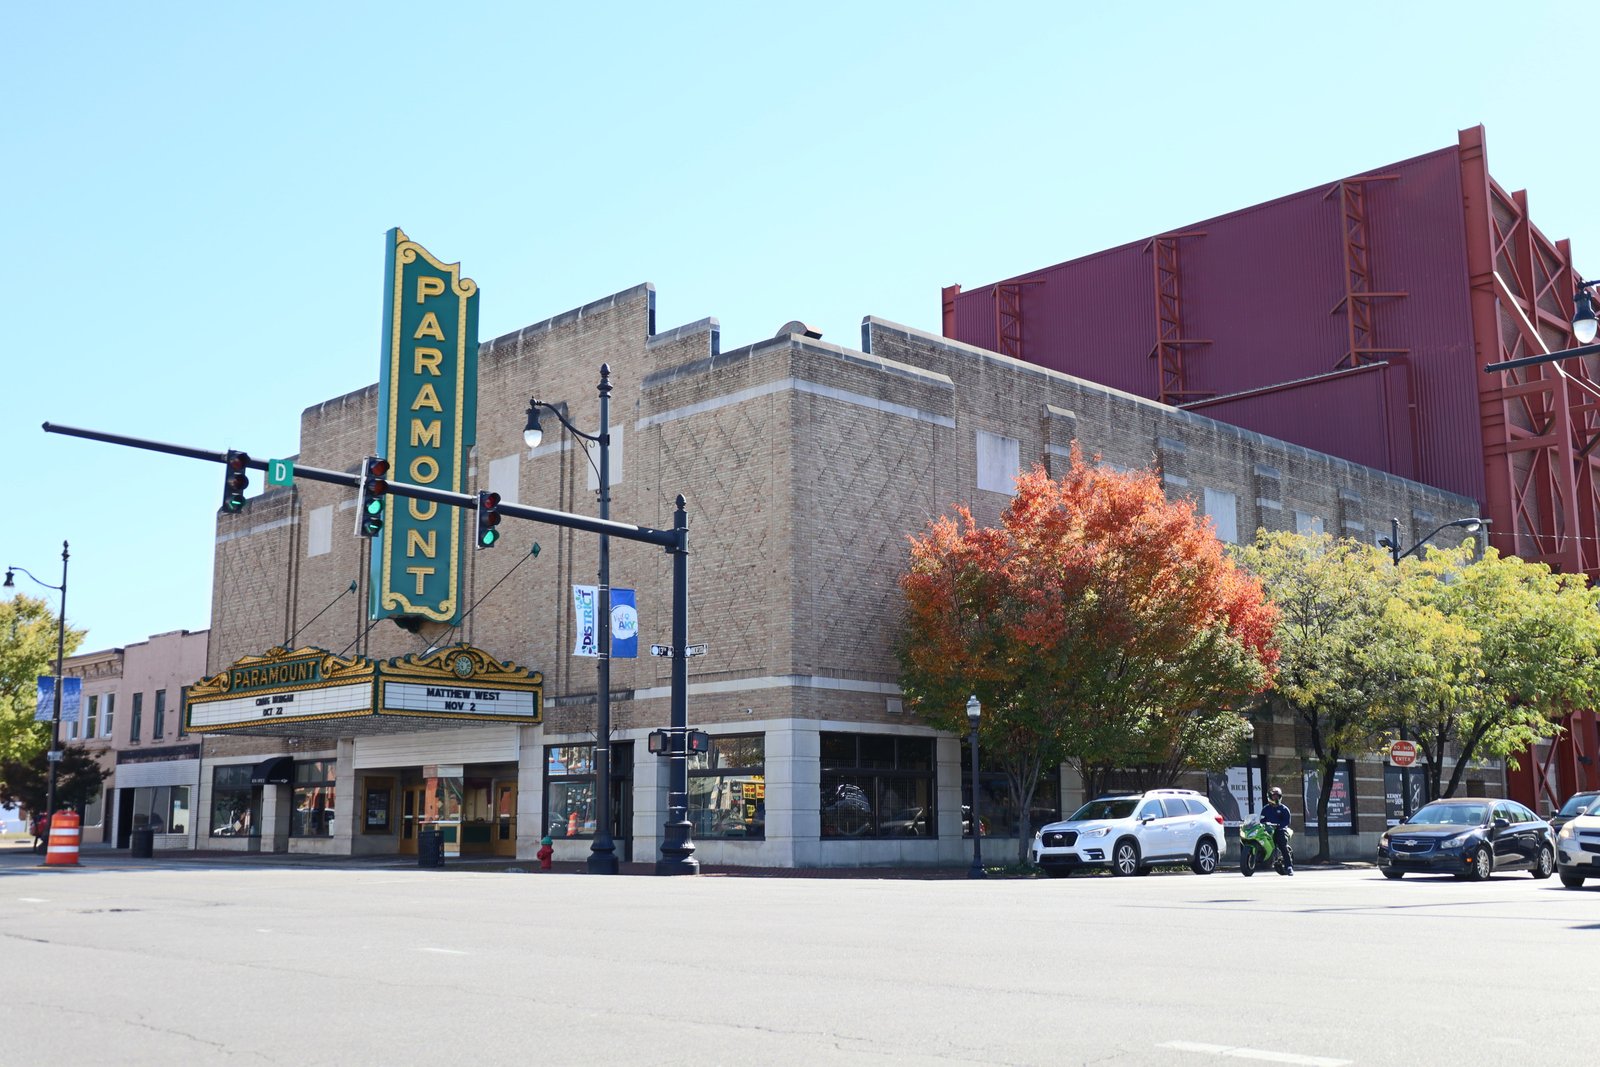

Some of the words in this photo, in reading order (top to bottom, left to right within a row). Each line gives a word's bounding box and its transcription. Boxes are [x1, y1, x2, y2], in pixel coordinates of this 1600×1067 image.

[406, 275, 446, 596] PARAMOUNT
[274, 462, 287, 482] D
[582, 589, 593, 646] DISTRICT
[618, 620, 636, 630] AKY
[233, 660, 317, 689] PARAMOUNT
[426, 687, 472, 700] MATTHEW
[474, 690, 501, 701] WEST
[262, 707, 273, 717] OCT
[444, 701, 465, 711] NOV
[469, 702, 476, 712] 2
